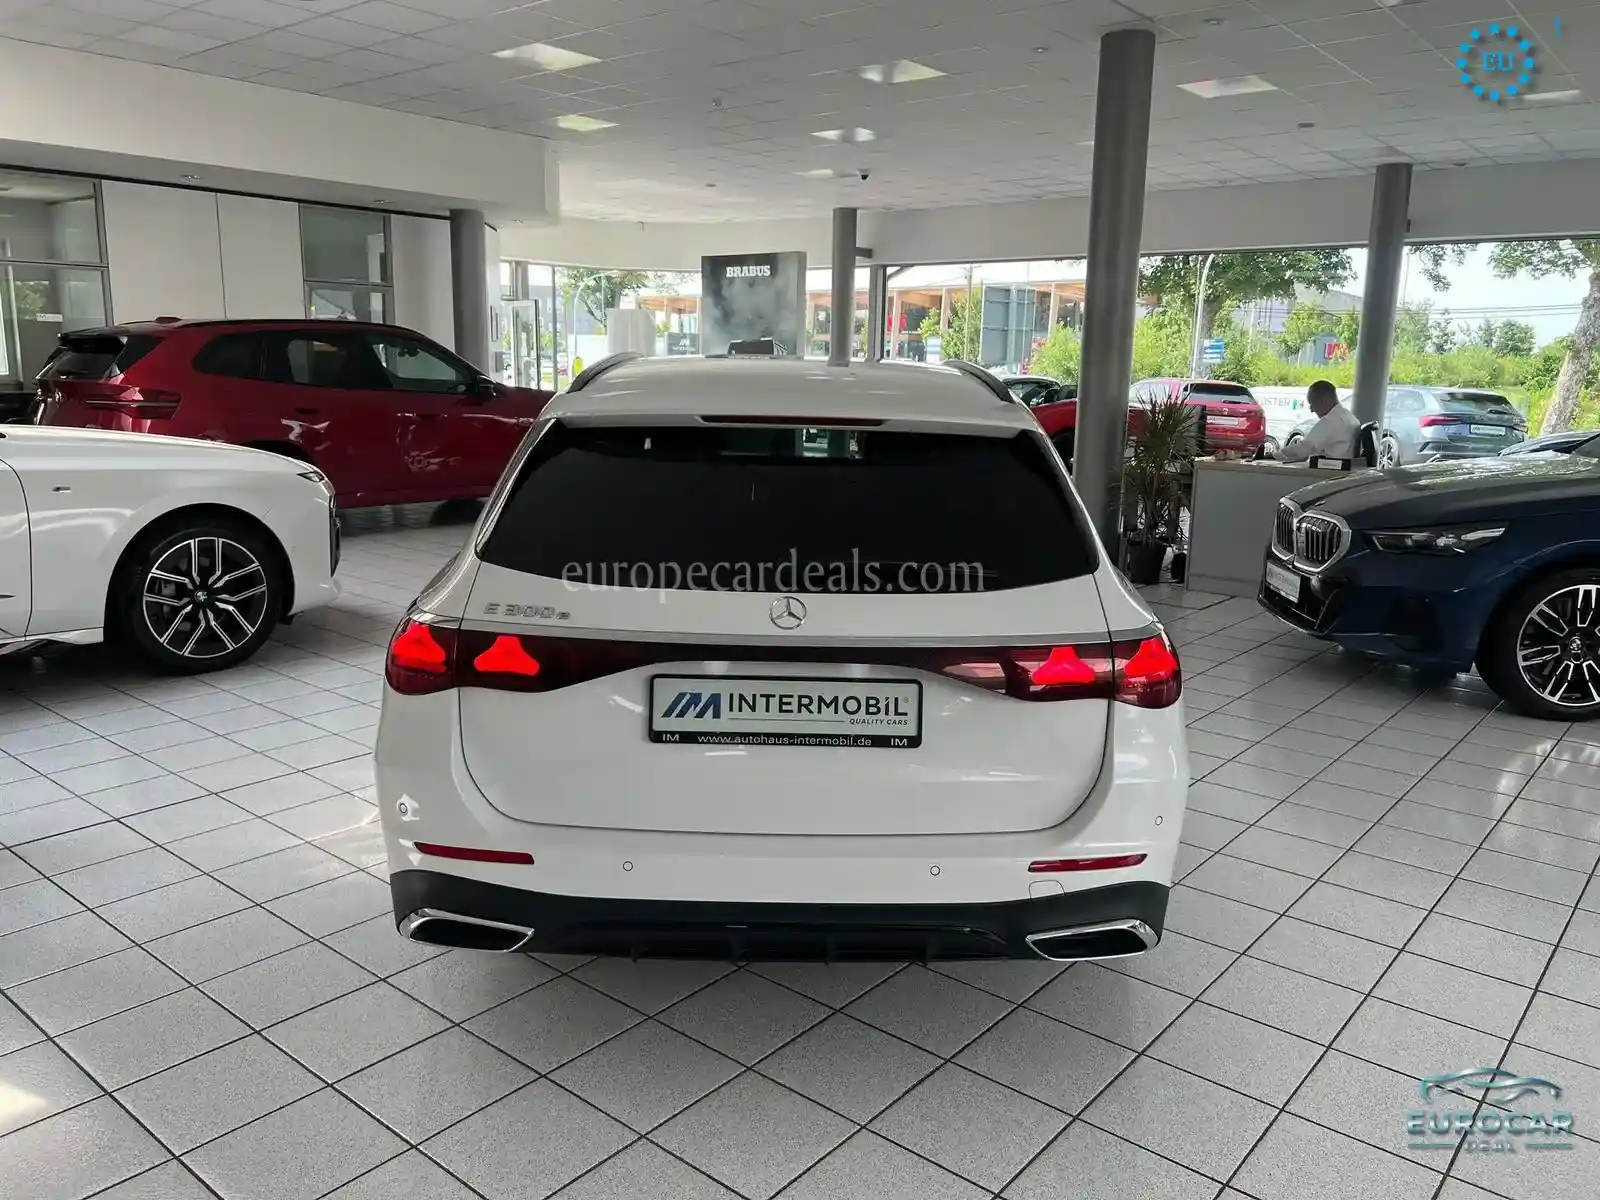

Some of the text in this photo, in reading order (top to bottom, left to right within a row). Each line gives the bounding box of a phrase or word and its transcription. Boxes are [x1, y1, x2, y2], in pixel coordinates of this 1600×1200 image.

[726, 265, 771, 278] BRABUS
[484, 603, 500, 614] E
[849, 718, 884, 726] QUALITY
[662, 733, 908, 746] IM www.autohaus-intermobil.de IM
